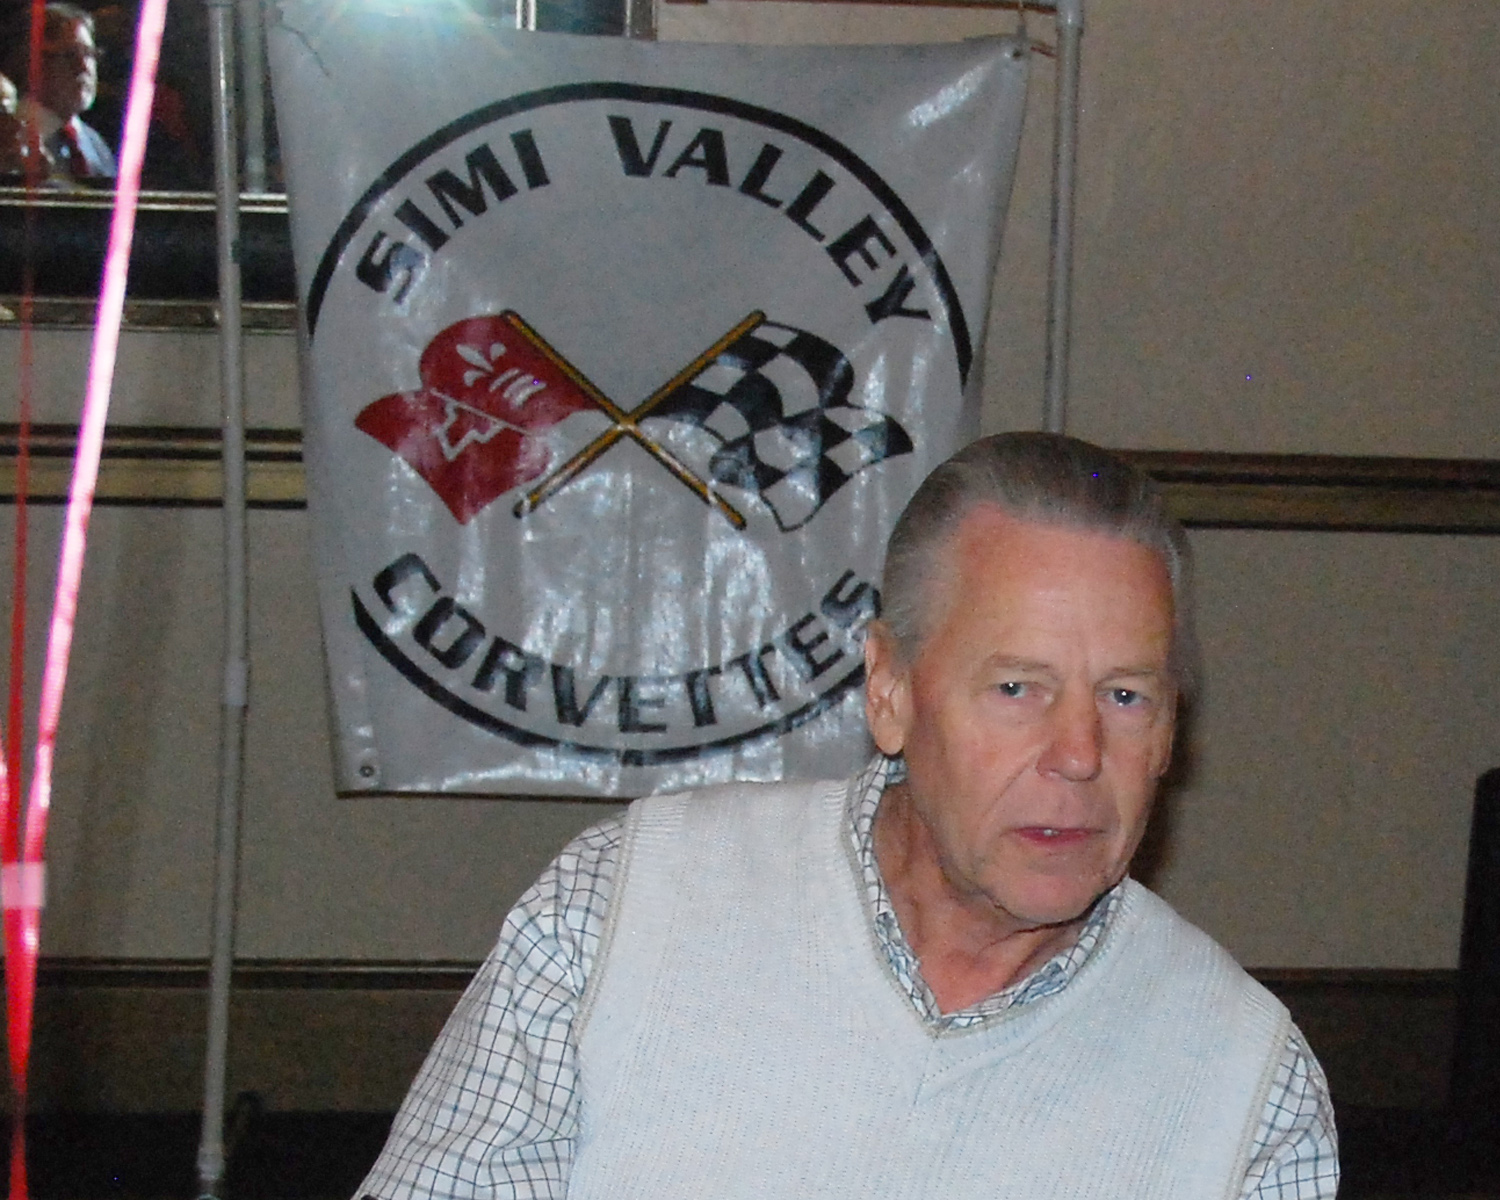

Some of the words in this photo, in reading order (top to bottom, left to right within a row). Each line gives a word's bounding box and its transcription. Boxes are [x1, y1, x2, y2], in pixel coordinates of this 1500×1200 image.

[356, 129, 551, 304] SIMI
[606, 114, 932, 325] VALLEY
[372, 552, 882, 734] CORVETTES
